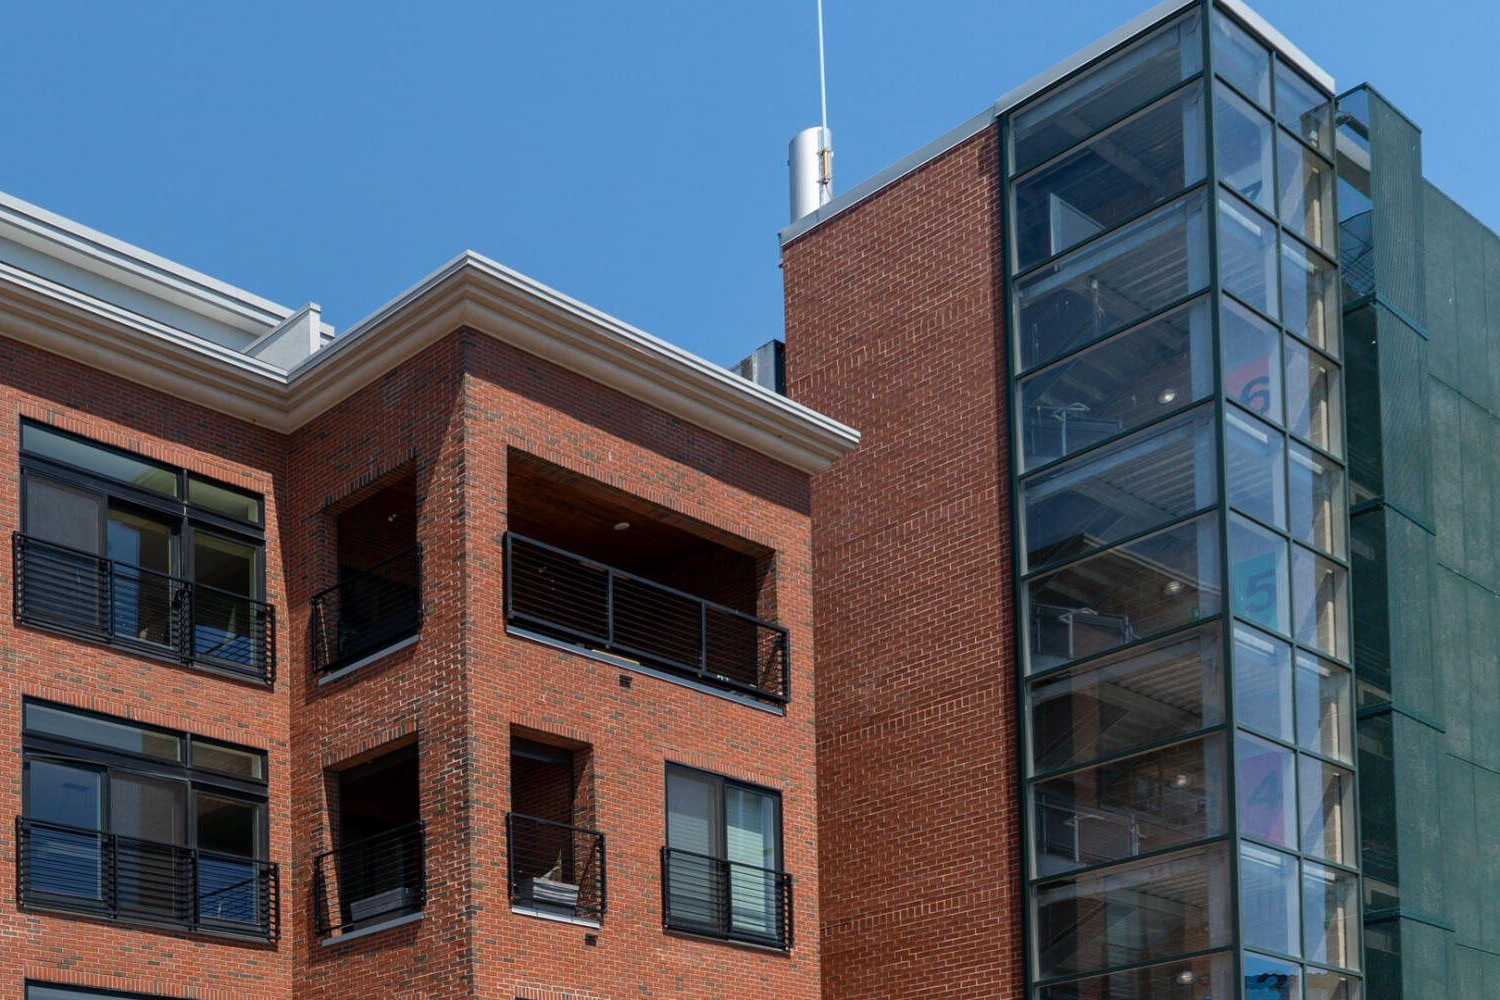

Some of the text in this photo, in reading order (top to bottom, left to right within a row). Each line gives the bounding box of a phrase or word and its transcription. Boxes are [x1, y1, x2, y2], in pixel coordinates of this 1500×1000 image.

[1240, 375, 1270, 413] 6
[1244, 568, 1277, 612] 5
[1247, 769, 1284, 810] 4
